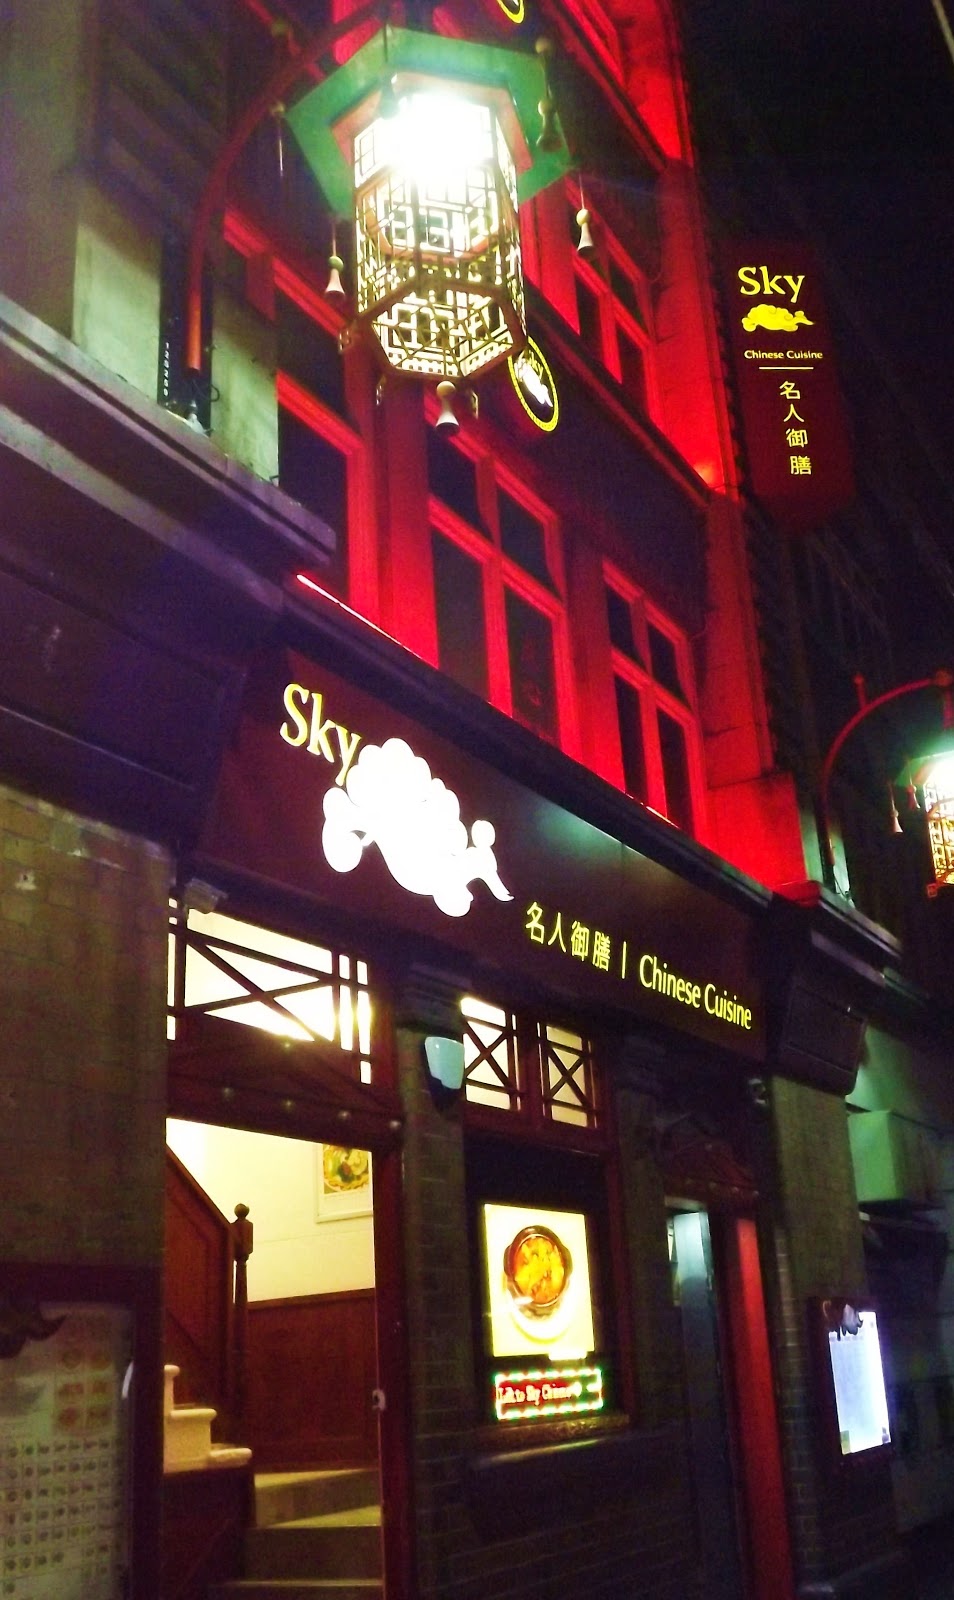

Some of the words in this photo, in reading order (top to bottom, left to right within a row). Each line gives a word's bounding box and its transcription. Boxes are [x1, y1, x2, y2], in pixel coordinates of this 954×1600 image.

[738, 266, 805, 303] Sky
[744, 350, 784, 359] Chinese
[786, 350, 823, 359] Cuisine
[780, 381, 811, 474] 名人御膳
[279, 683, 362, 787] Sky
[526, 902, 610, 971] 名人御膳
[640, 955, 701, 1008] Chinese
[704, 984, 751, 1029] Cuisine
